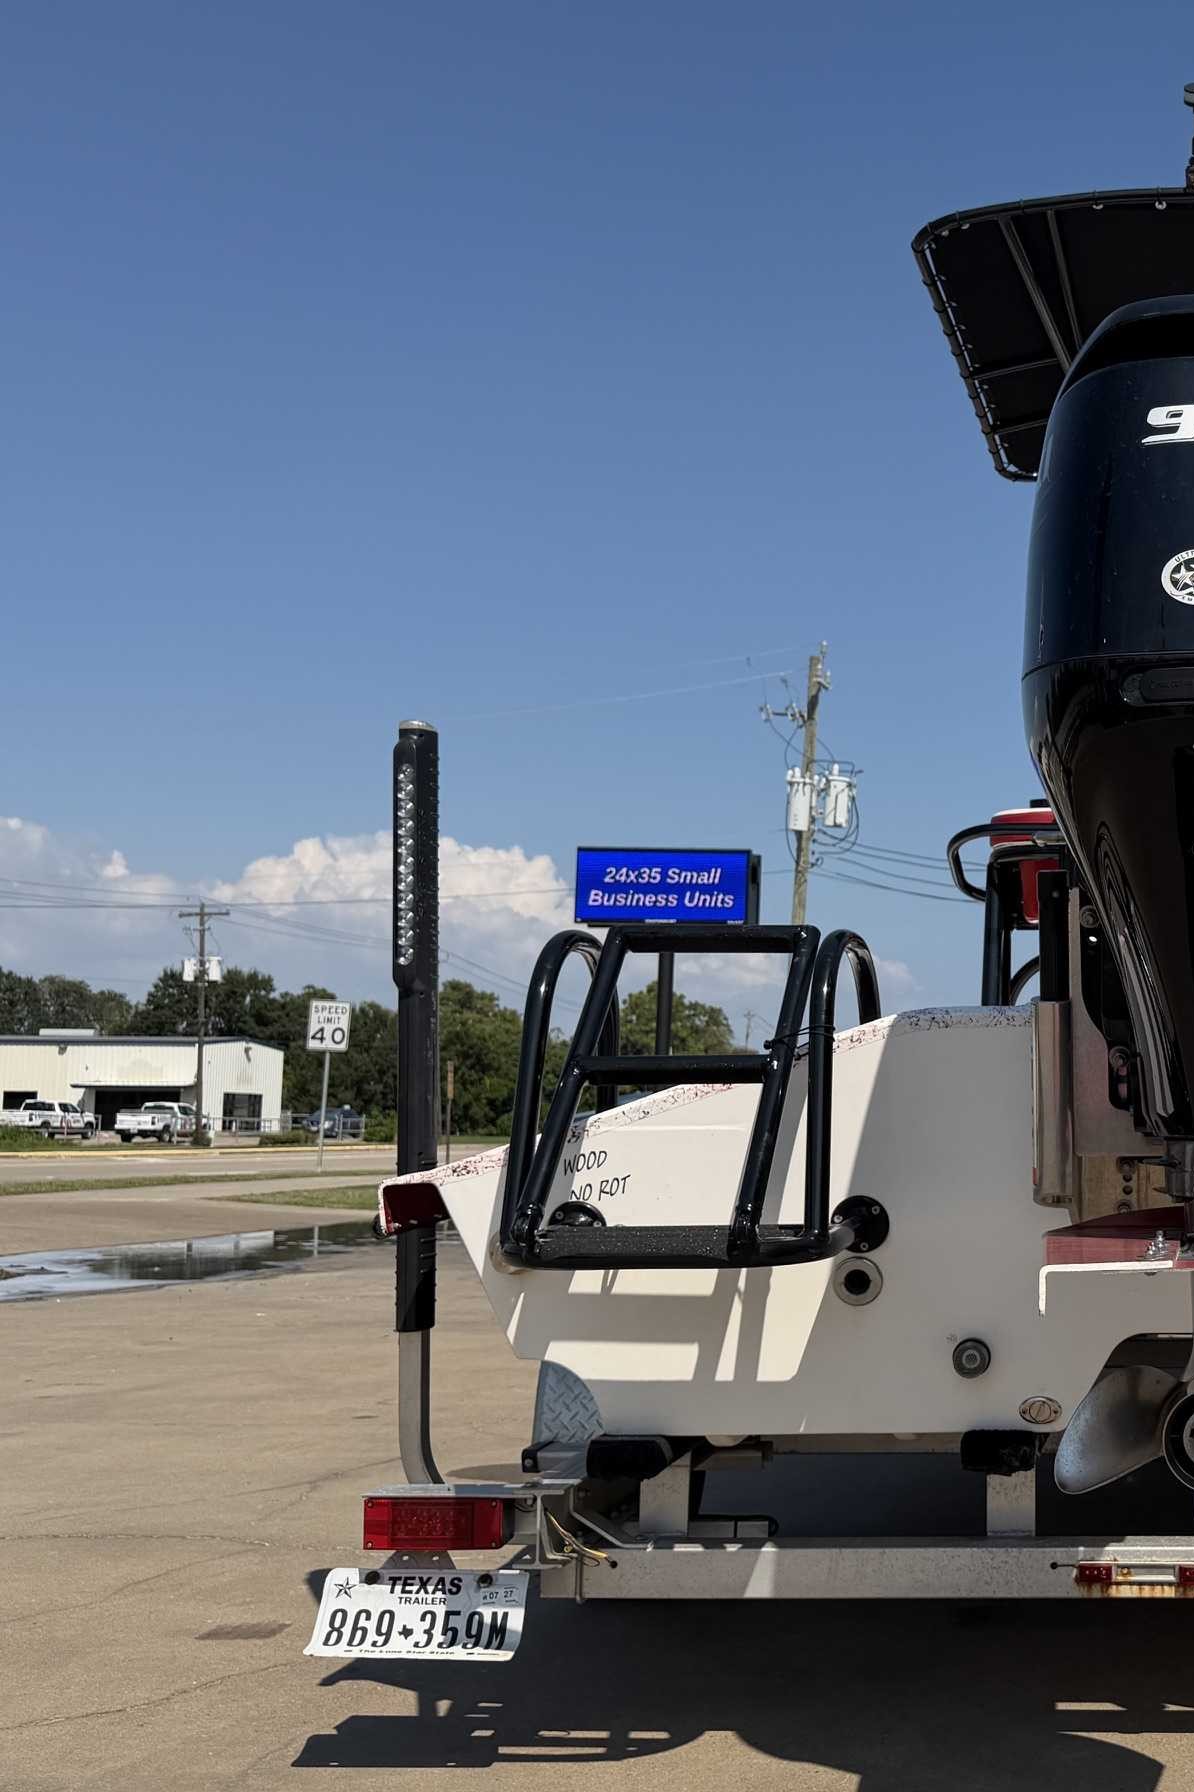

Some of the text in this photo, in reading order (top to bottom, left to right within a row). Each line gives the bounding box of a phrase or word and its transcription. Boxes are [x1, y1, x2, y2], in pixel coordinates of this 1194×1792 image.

[604, 867, 721, 884] 24x35 Small
[588, 889, 735, 908] Business Units
[314, 1005, 347, 1015] SPEED
[318, 1016, 341, 1024] LIMIT
[311, 1026, 345, 1044] 40
[564, 1151, 607, 1176] WOOD
[570, 1174, 631, 1201] NO ROT
[388, 1576, 463, 1595] TEXAS
[397, 1596, 448, 1606] TRAILER
